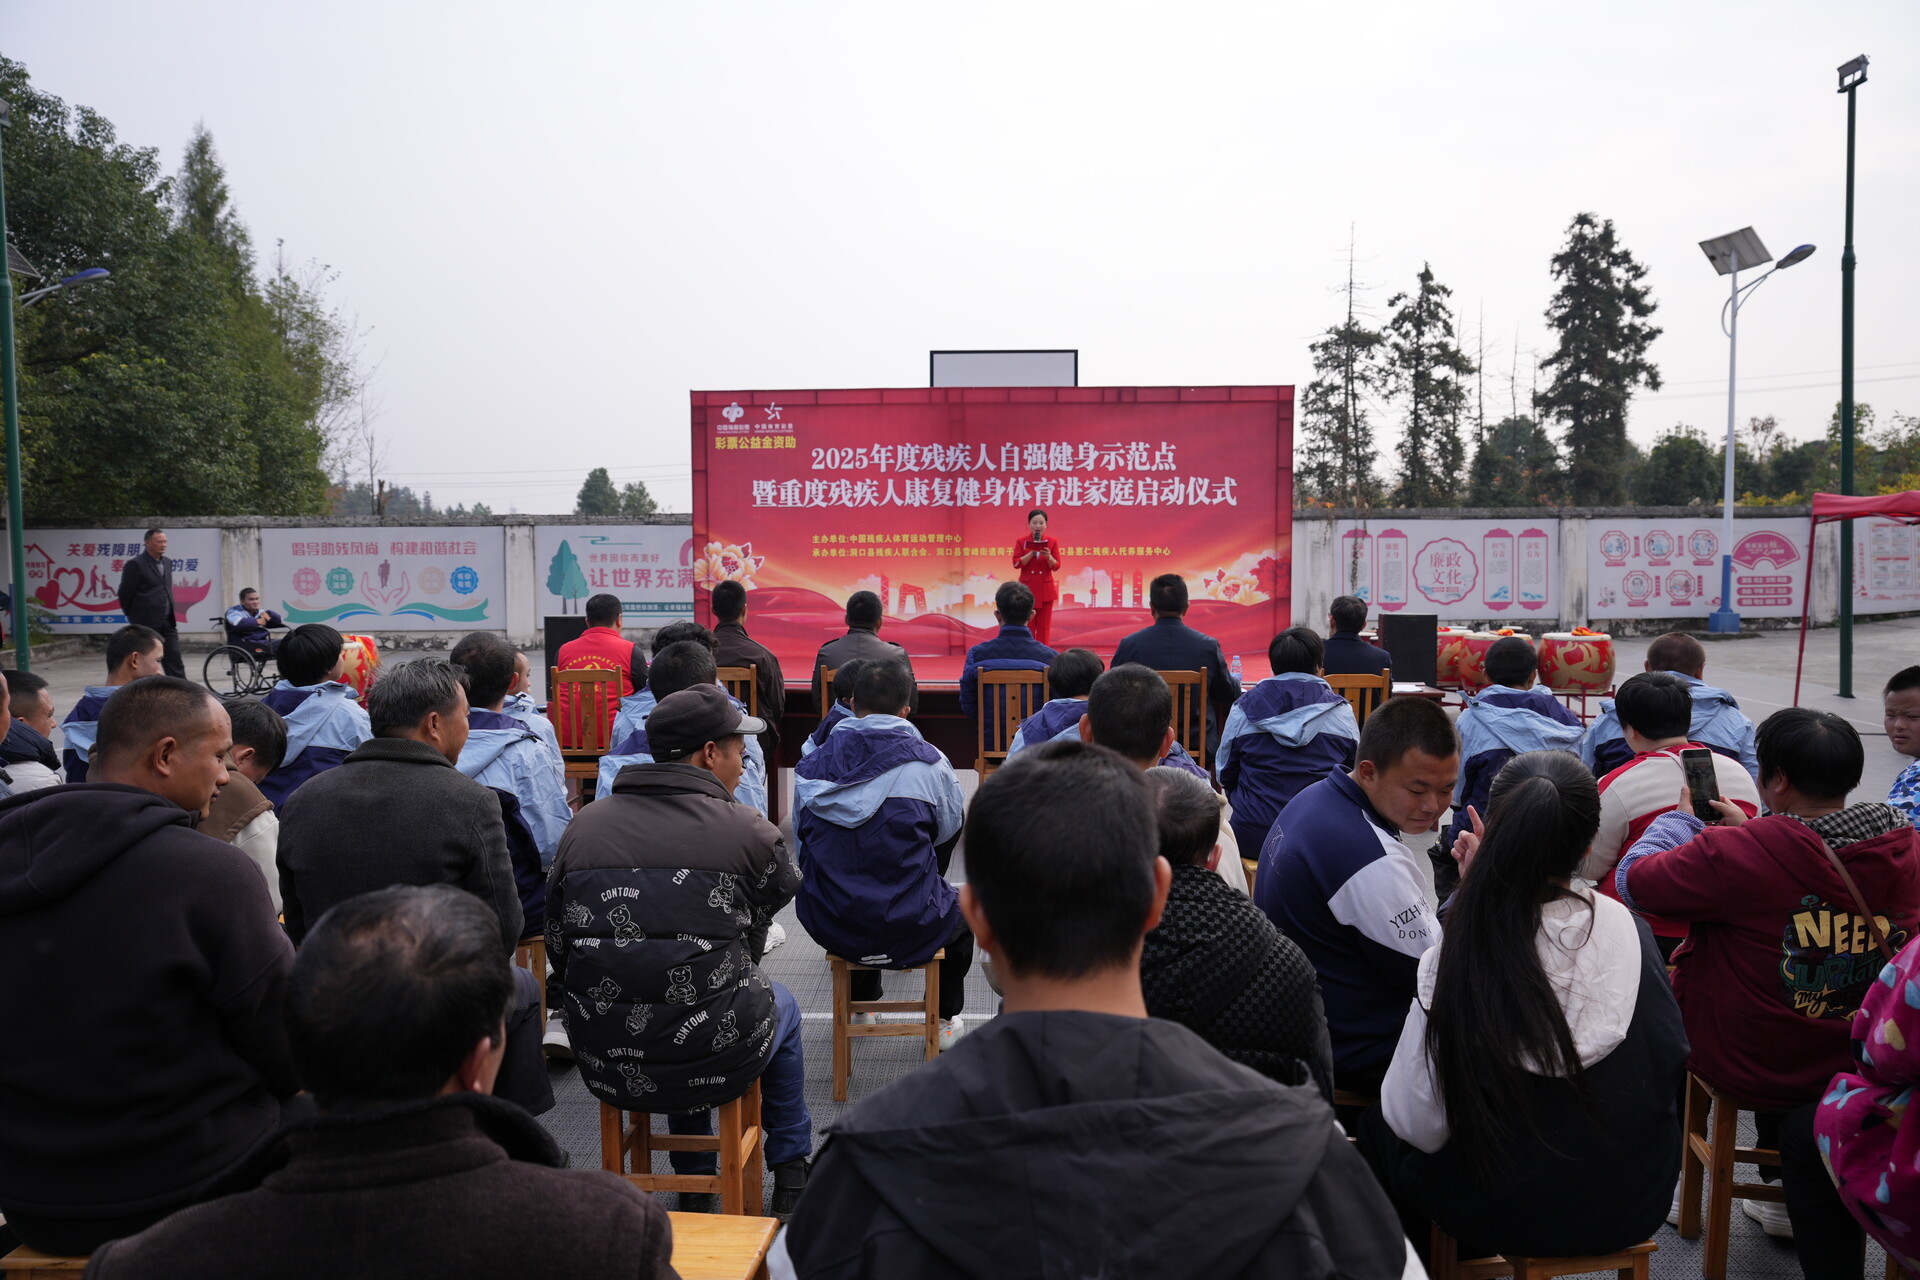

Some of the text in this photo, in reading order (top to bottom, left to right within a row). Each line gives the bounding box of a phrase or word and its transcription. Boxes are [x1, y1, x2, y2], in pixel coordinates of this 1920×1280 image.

[715, 436, 797, 450] 彩票公益金资助
[811, 441, 1177, 473] 2025年度残疾人自强健身示范点
[751, 476, 1238, 508] 暨重度残疾人康复健身体育进家庭启动仪式
[291, 541, 477, 556] 倡导助残风尚 构建和谐社会
[1432, 569, 1462, 585] 文化
[600, 886, 640, 902] CONTOUR
[1792, 910, 1890, 955] NEED
[573, 938, 600, 949] ONTOUR
[677, 933, 712, 952] CONTOUR
[673, 1010, 710, 1045] CONTOUR
[607, 1047, 644, 1059] CONTOUR
[688, 1075, 726, 1087] CONTOUR
